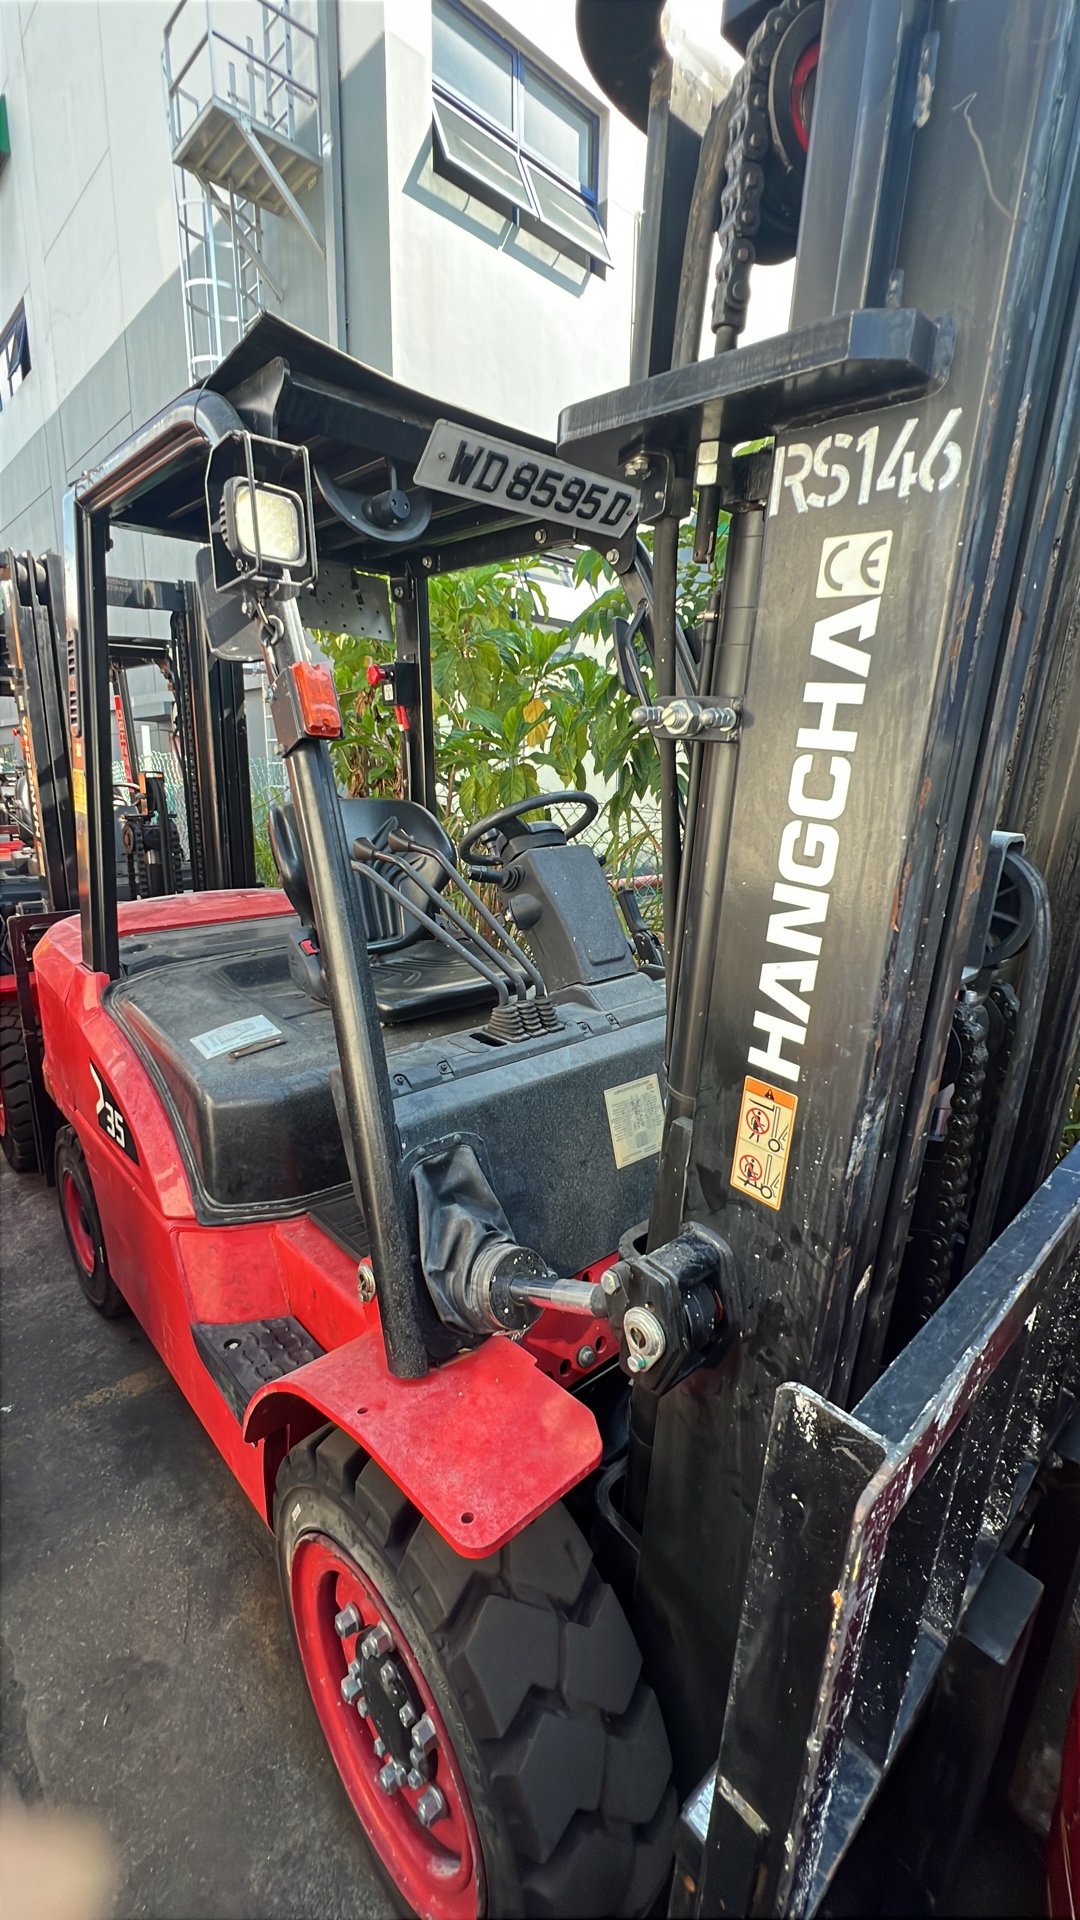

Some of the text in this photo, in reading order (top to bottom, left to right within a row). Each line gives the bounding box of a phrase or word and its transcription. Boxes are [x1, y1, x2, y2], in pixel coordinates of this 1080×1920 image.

[448, 440, 632, 526] WD8595D
[769, 407, 963, 518] RS146
[746, 597, 881, 1083] HANGCHA
